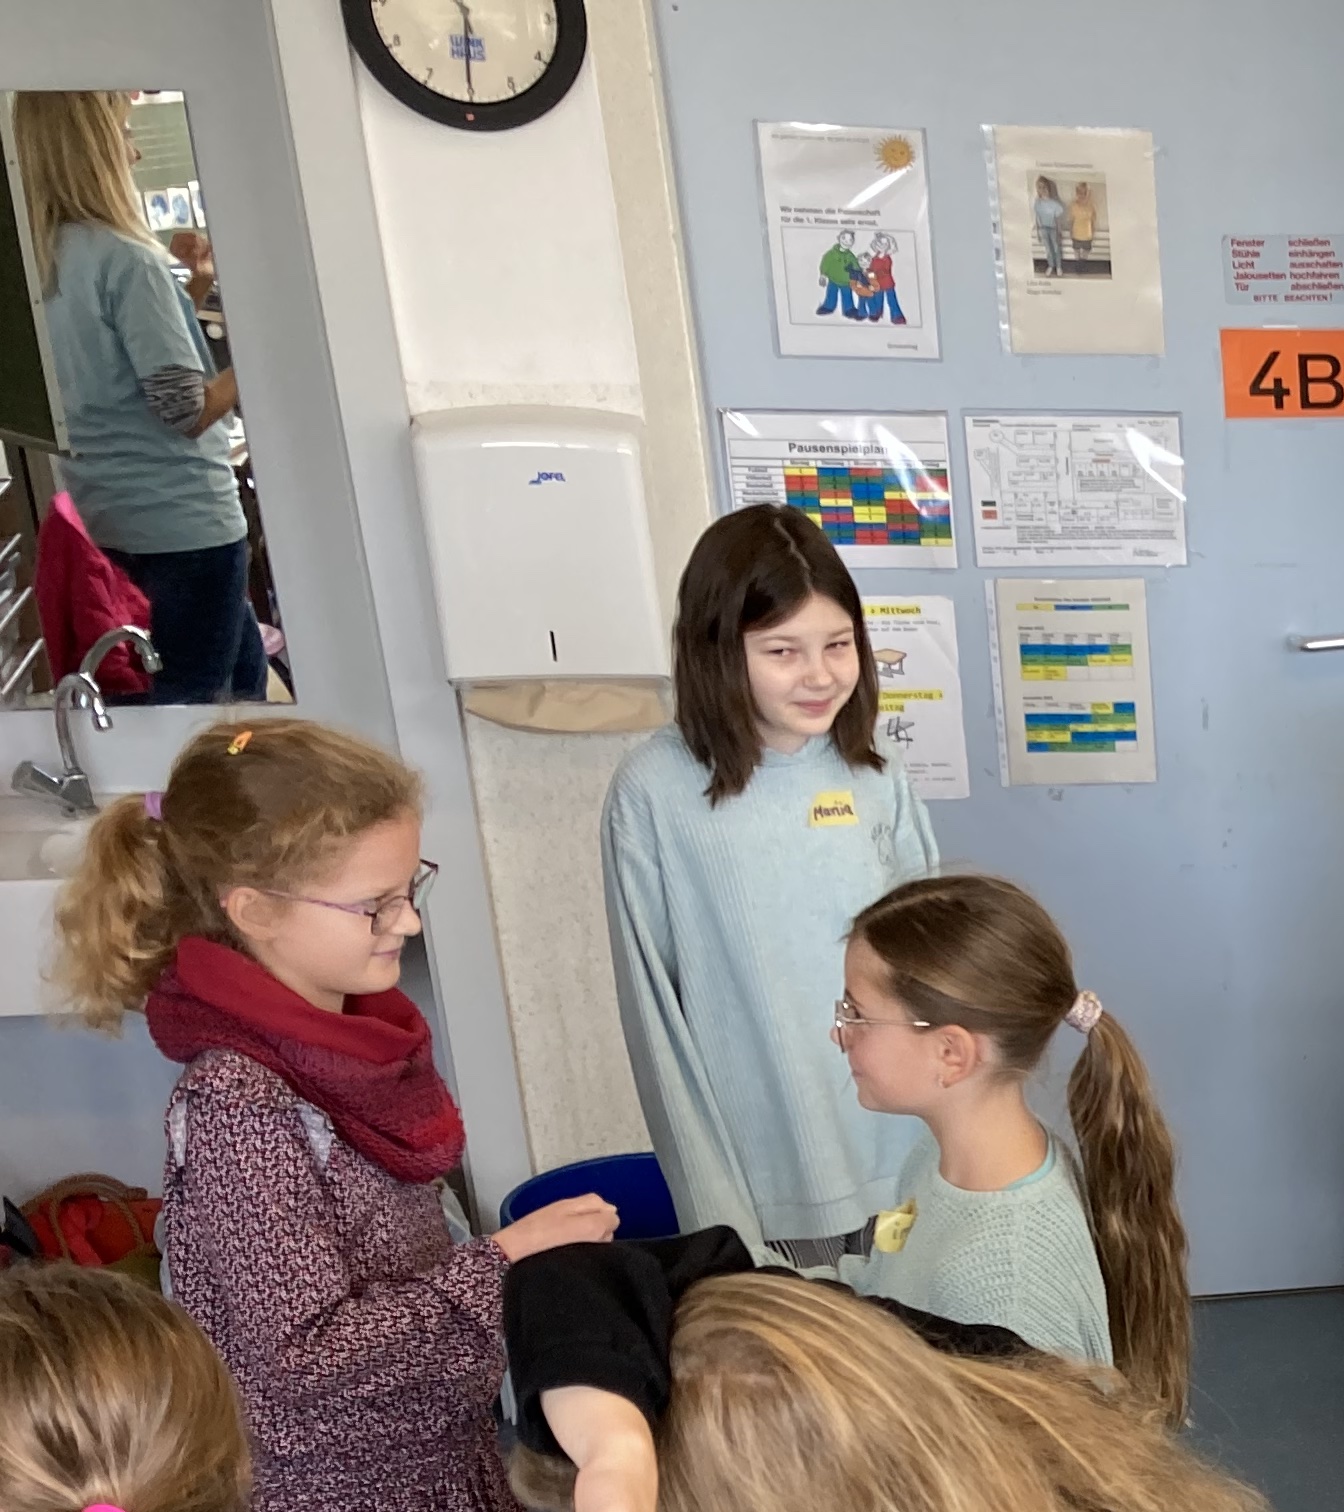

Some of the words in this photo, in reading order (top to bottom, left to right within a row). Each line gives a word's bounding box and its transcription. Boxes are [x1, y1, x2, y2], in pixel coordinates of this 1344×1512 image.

[1231, 238, 1265, 247] Fenster
[1288, 238, 1331, 247] schließen
[1232, 249, 1260, 258] Stühle
[1289, 249, 1335, 259] einhängen
[1232, 261, 1255, 269] Licht
[1290, 271, 1340, 280] hochfahren
[1253, 294, 1279, 302] BITTE
[1249, 351, 1344, 411] 4B
[882, 692, 934, 700] Donnerstag
